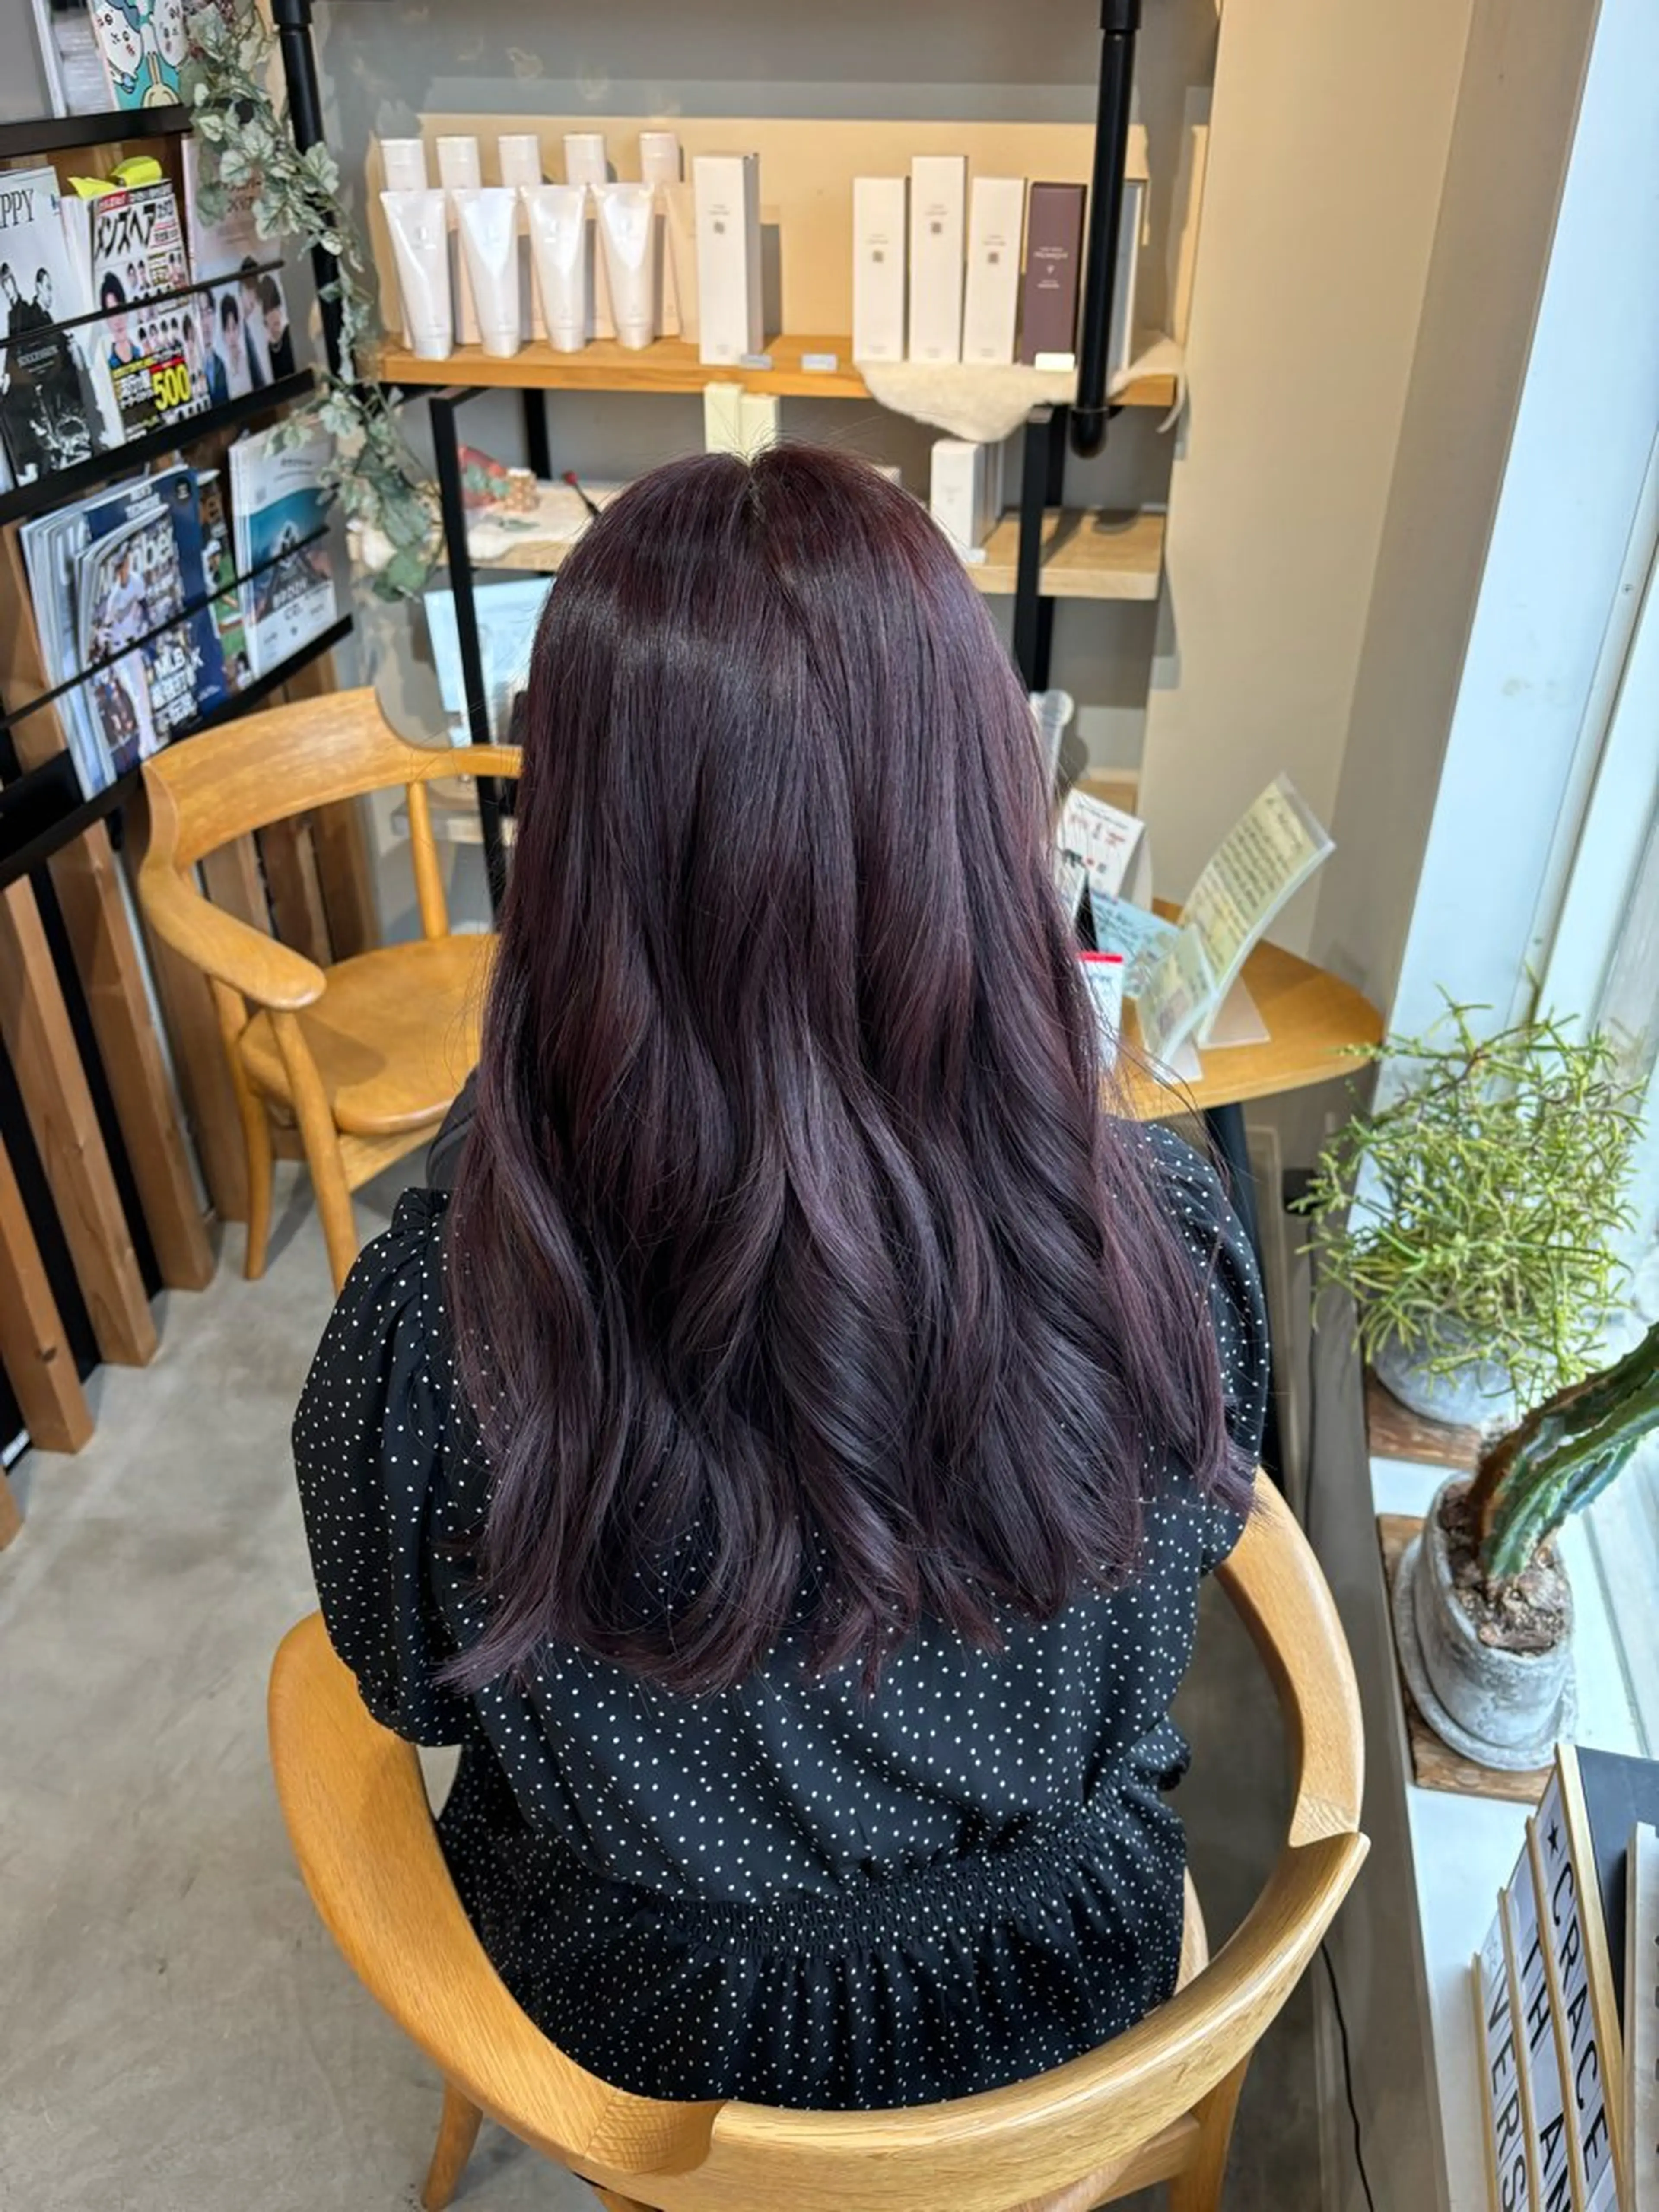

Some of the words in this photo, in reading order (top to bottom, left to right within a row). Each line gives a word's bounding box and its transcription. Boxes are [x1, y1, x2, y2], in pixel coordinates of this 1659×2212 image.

[94, 202, 156, 262] メンズヘア
[152, 364, 191, 410] 500
